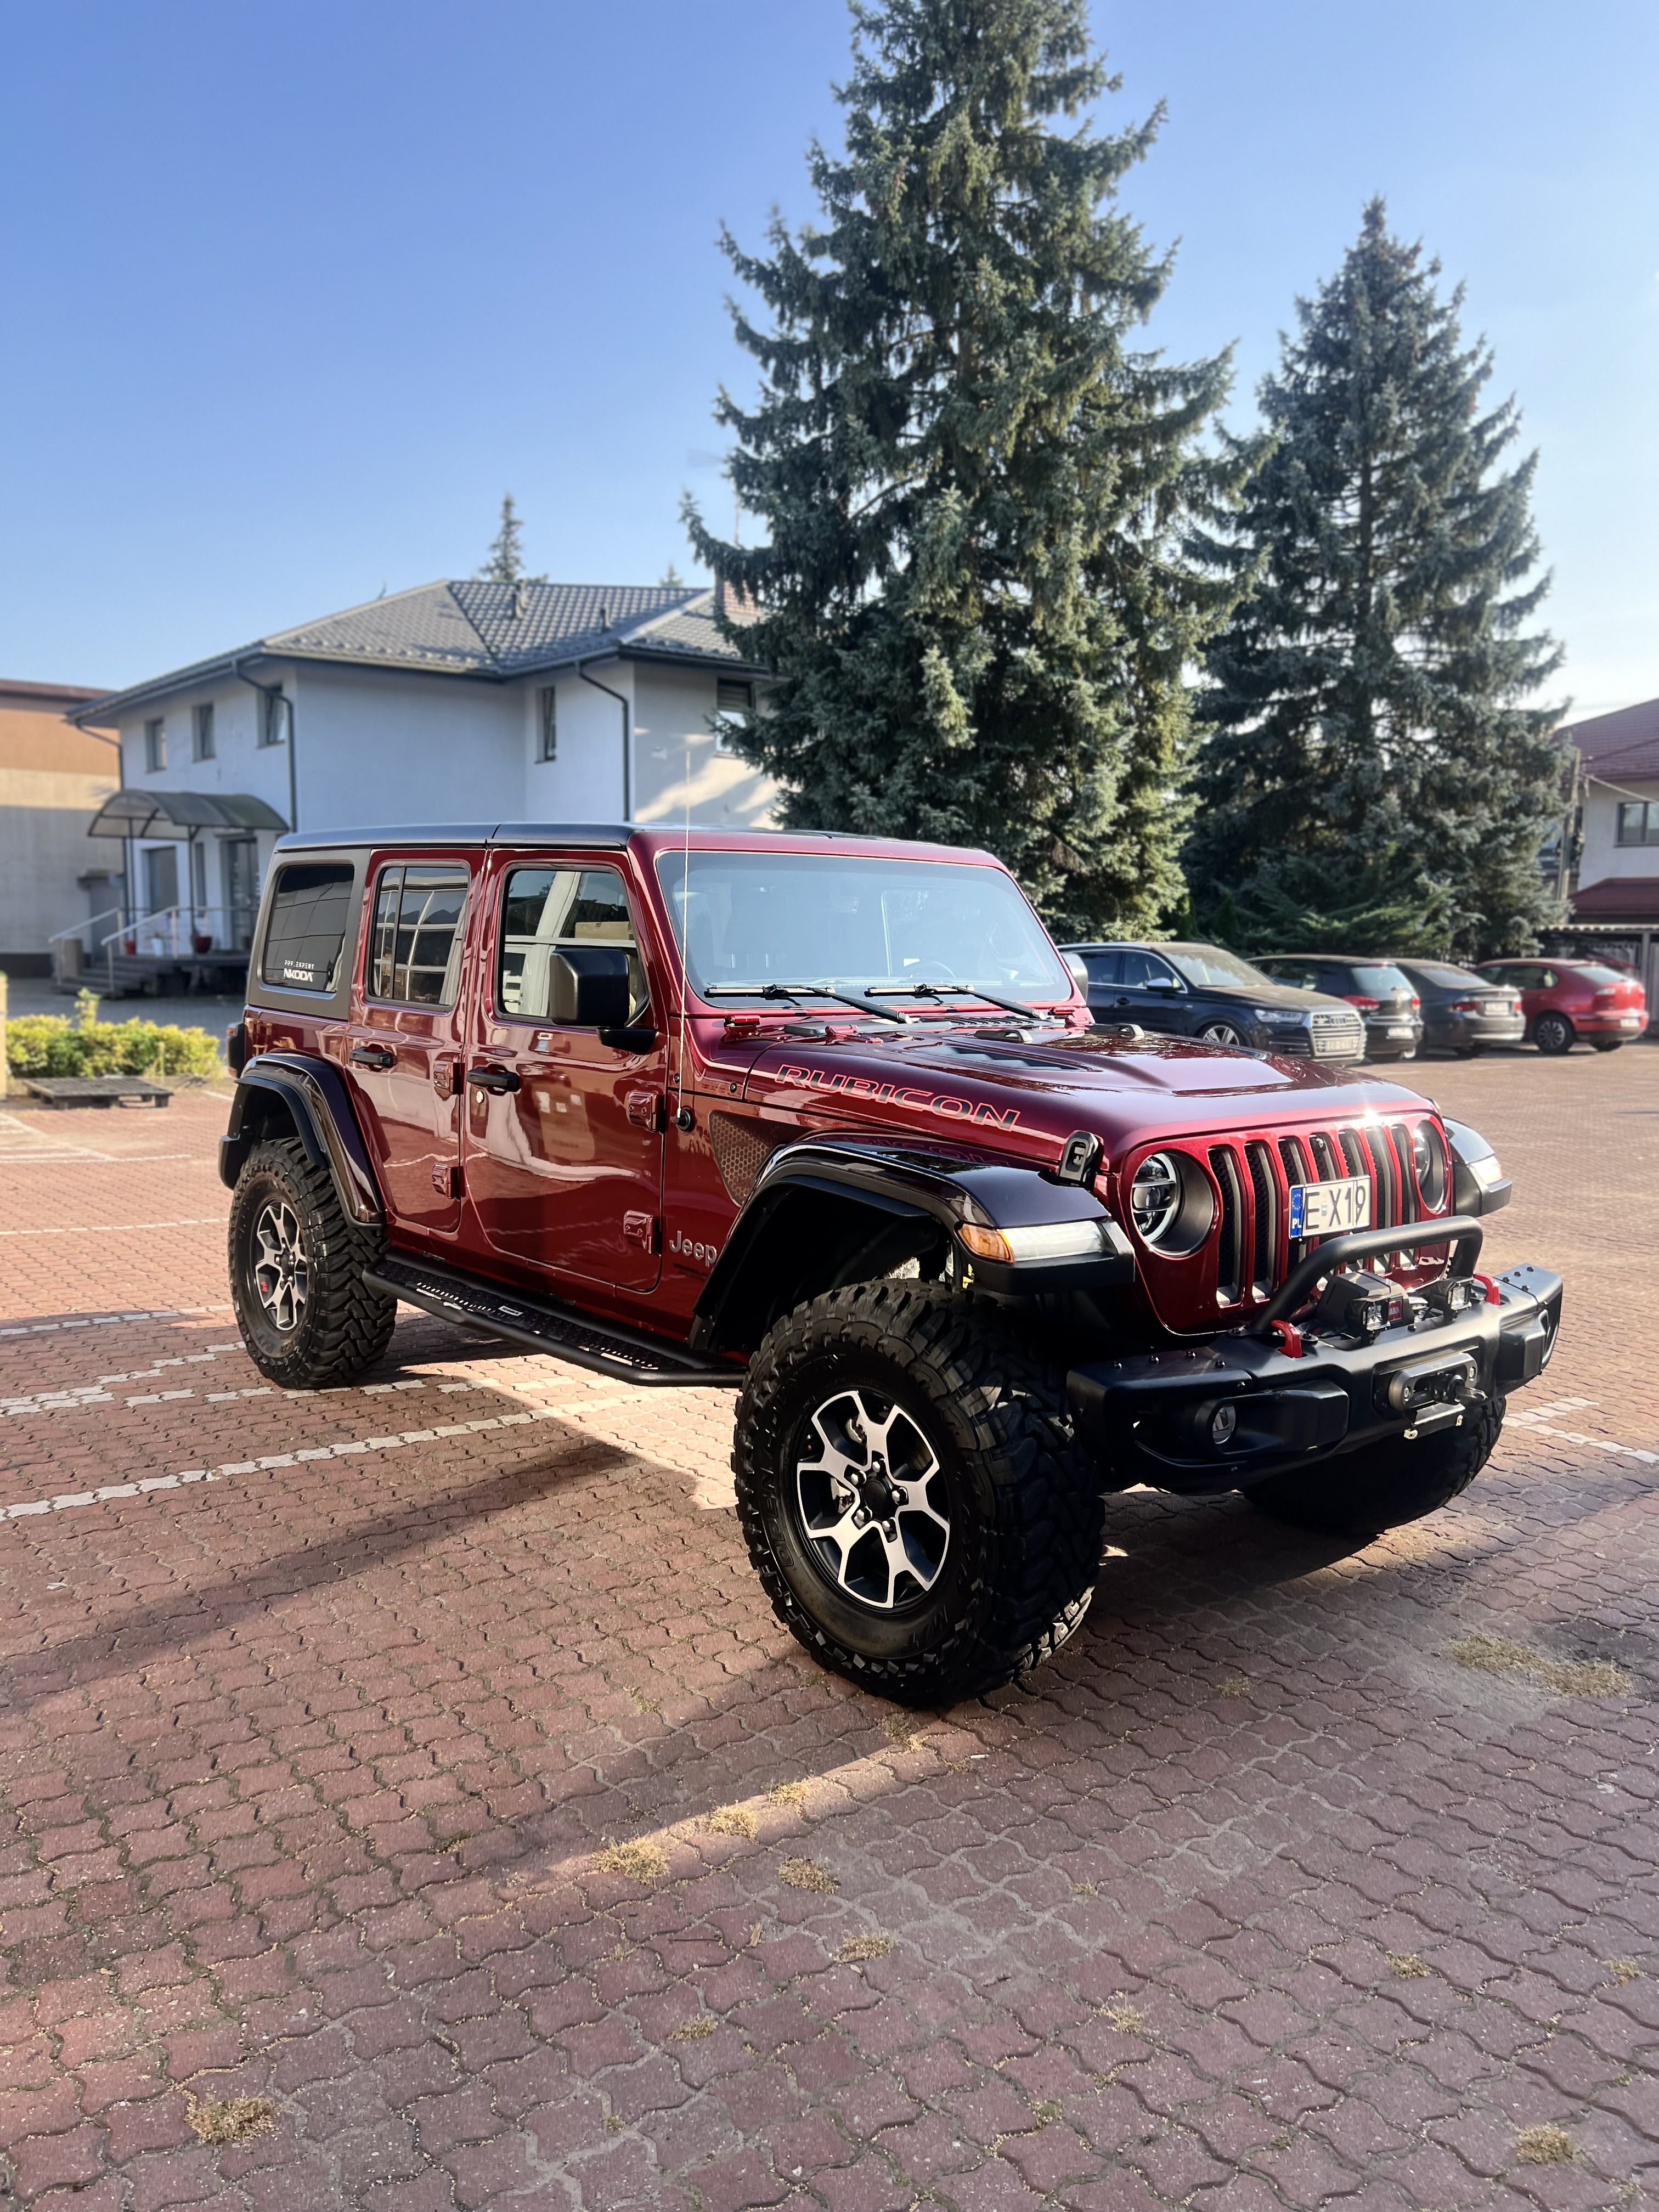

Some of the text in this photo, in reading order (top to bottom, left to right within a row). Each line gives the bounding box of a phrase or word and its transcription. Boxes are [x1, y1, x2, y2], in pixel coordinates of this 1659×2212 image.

[284, 968, 314, 982] NKODA
[774, 1064, 1020, 1132] RUBICON
[1306, 1185, 1366, 1229] E X19
[1292, 1218, 1302, 1229] PL
[669, 1231, 717, 1267] Jeep
[1389, 1306, 1400, 1316] ARN
